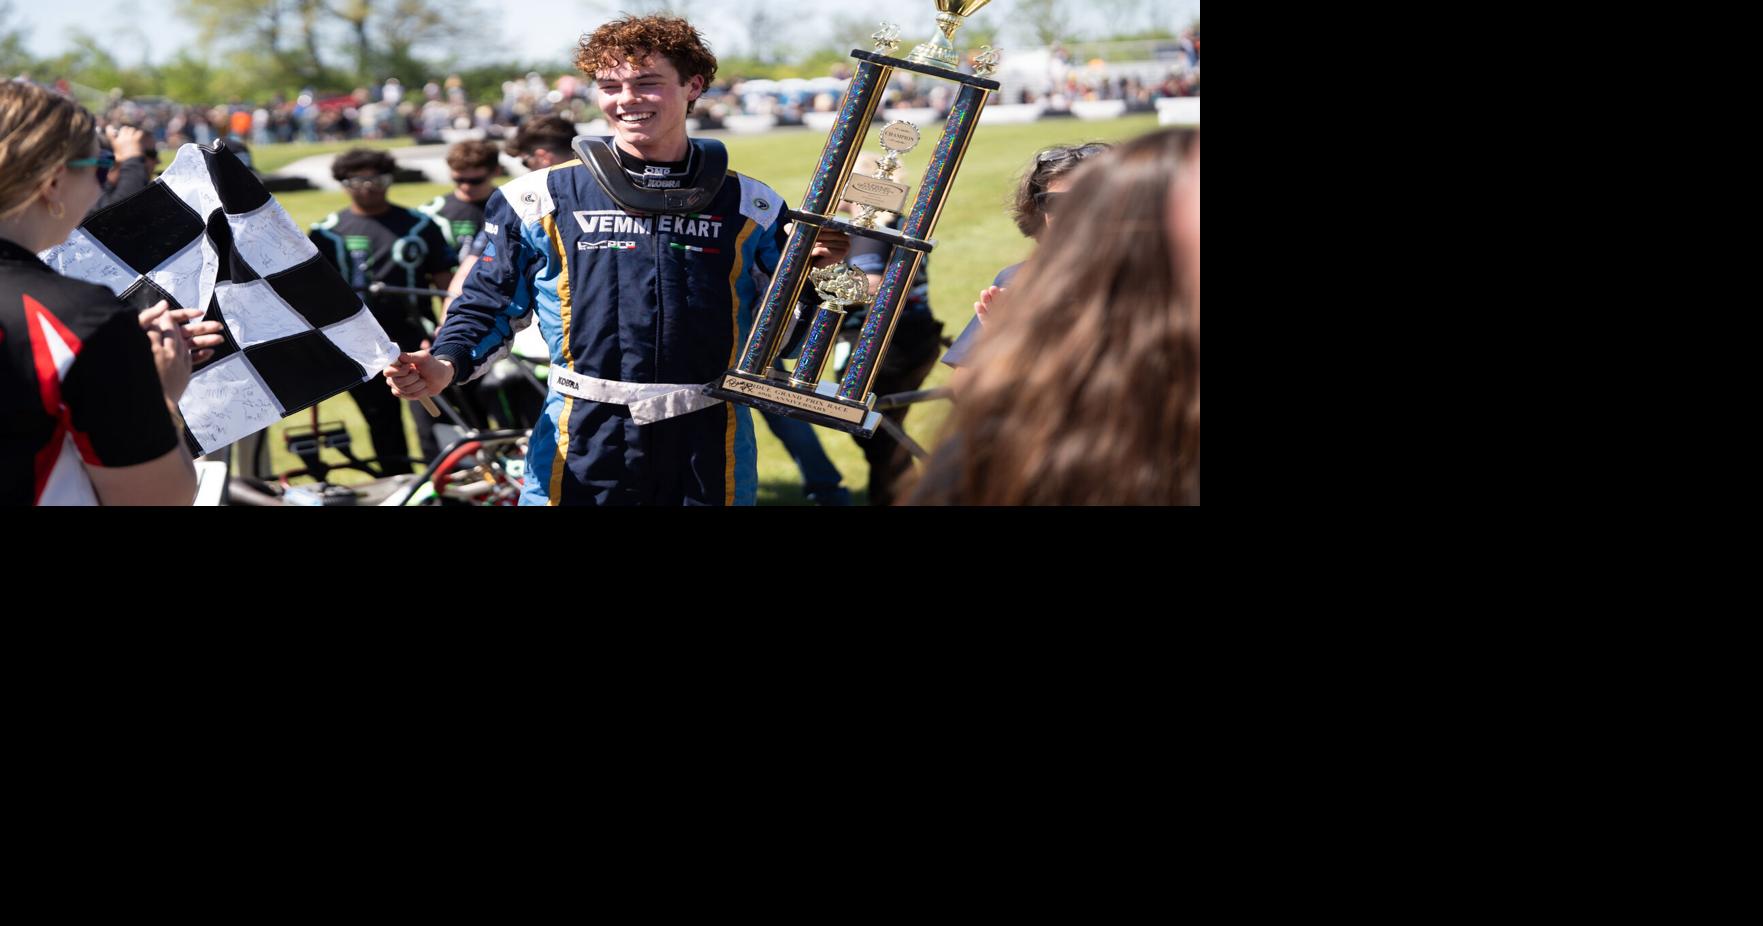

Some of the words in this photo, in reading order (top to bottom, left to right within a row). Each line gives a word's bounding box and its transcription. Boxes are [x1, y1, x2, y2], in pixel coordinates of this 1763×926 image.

[884, 130, 914, 142] CHAMPION
[644, 165, 671, 176] OMP
[647, 179, 680, 188] KOBRA
[557, 376, 580, 391] KOBRA
[775, 389, 803, 401] GRAND
[805, 397, 824, 407] PRIX
[827, 402, 850, 413] RACE
[776, 396, 827, 412] ANNIVERSARY
